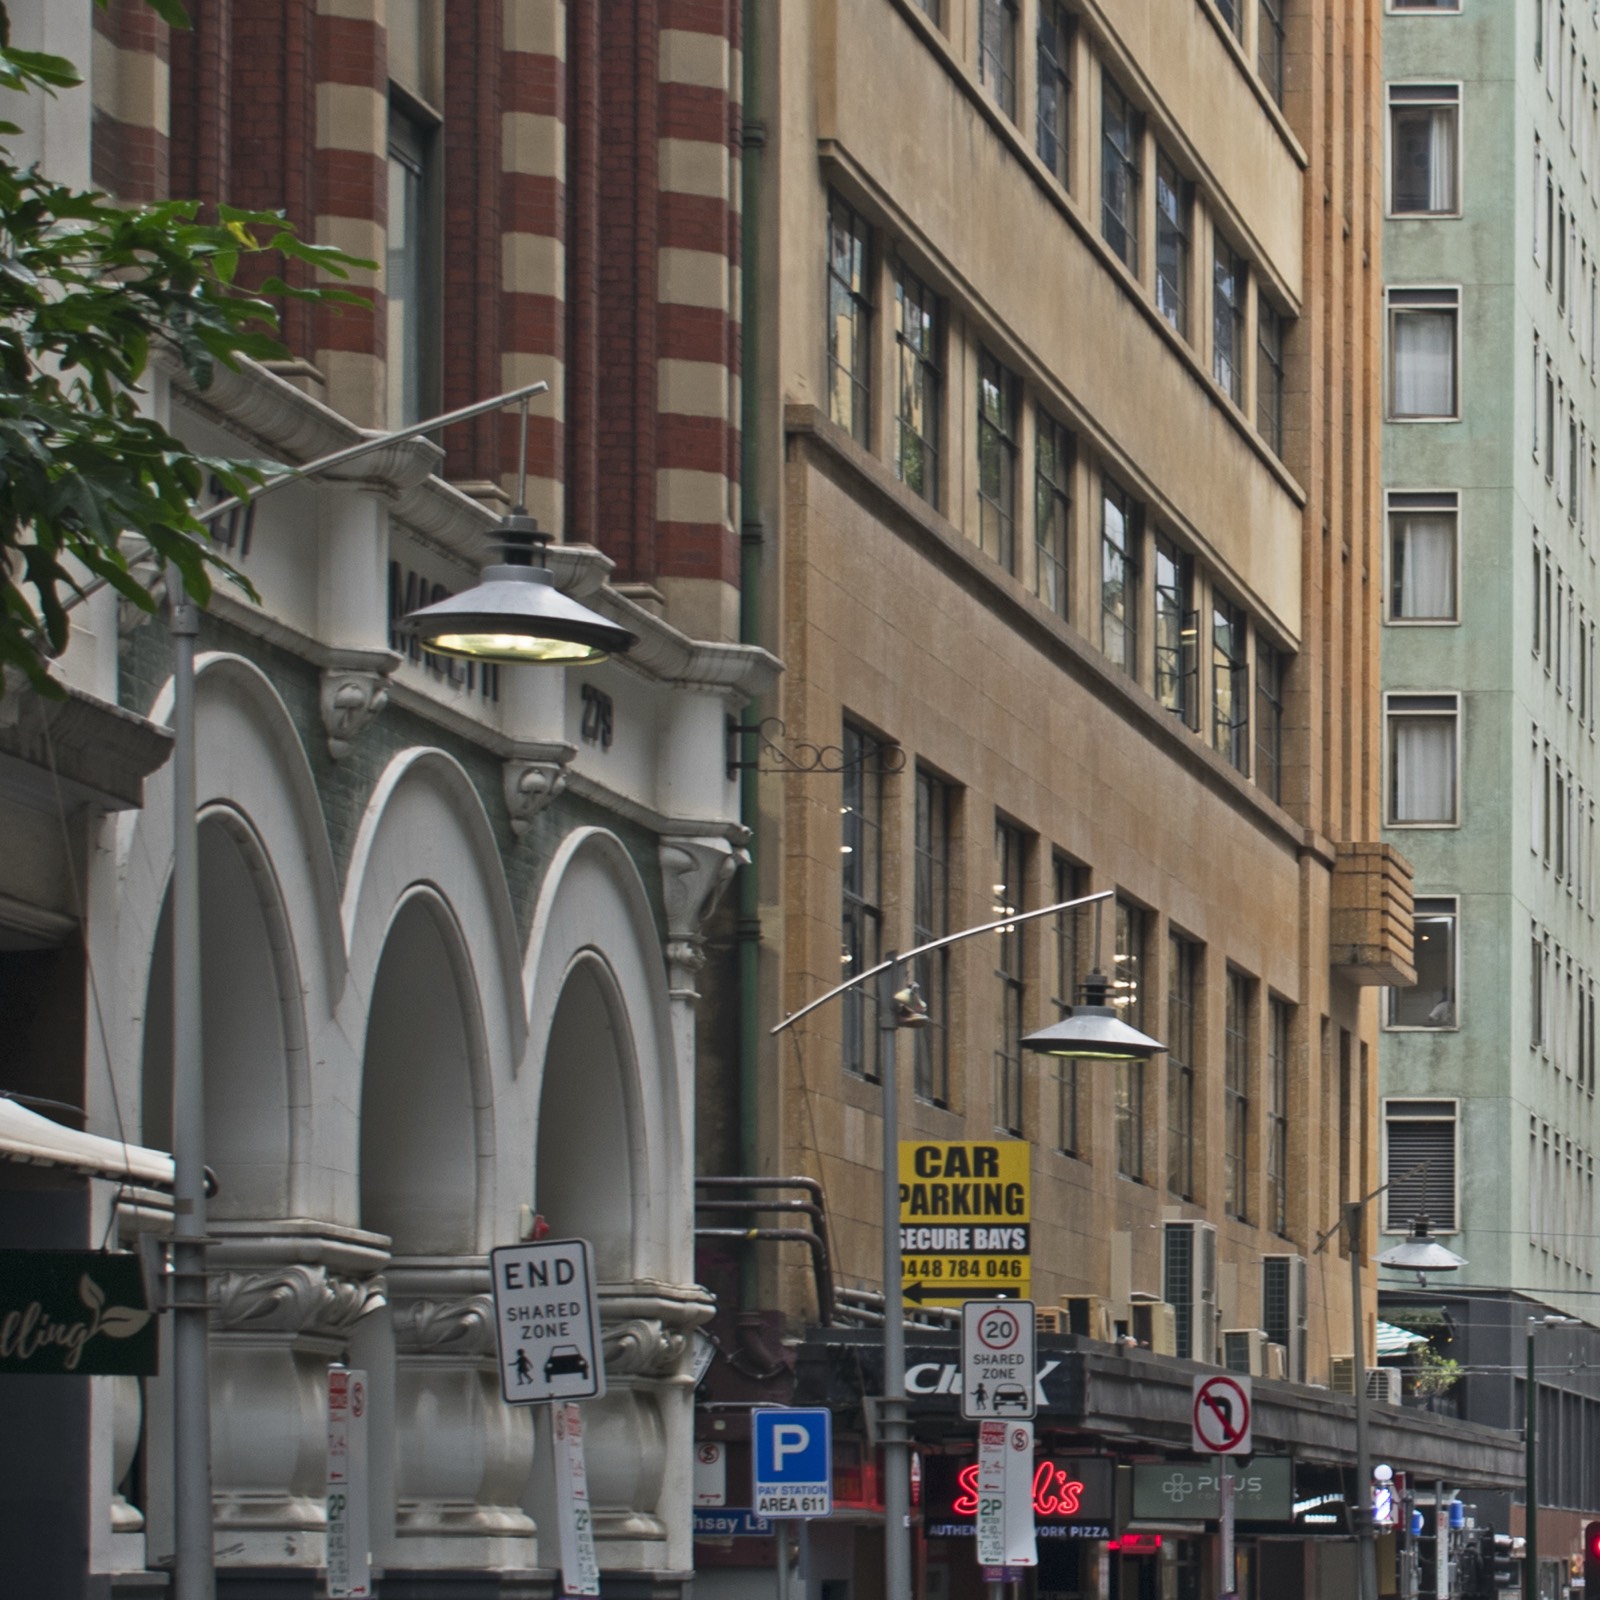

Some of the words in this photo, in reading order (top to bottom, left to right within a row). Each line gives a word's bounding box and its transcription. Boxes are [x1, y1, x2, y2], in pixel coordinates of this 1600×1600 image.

[581, 683, 613, 747] 279
[914, 1146, 999, 1178] CAR
[898, 1183, 1024, 1216] PARKING
[900, 1228, 970, 1250] SECURE
[974, 1228, 1026, 1250] BAYS
[505, 1258, 575, 1289] END
[948, 1260, 980, 1277] 784
[986, 1260, 1022, 1277] 046
[507, 1302, 581, 1321] SHARED
[521, 1322, 570, 1339] ZONE
[986, 1321, 1013, 1338] 20
[973, 1354, 1025, 1365] SHARED
[982, 1368, 1016, 1379] ZONE
[773, 1424, 810, 1472] P
[758, 1485, 777, 1495] PAY
[781, 1485, 827, 1495] STATION
[953, 1460, 1085, 1515] Sl's
[1198, 1476, 1262, 1492] PLUS
[759, 1498, 799, 1511] AREA
[802, 1498, 826, 1511] 611
[980, 1499, 1002, 1516] 2P
[1070, 1527, 1110, 1538] PIZZA
